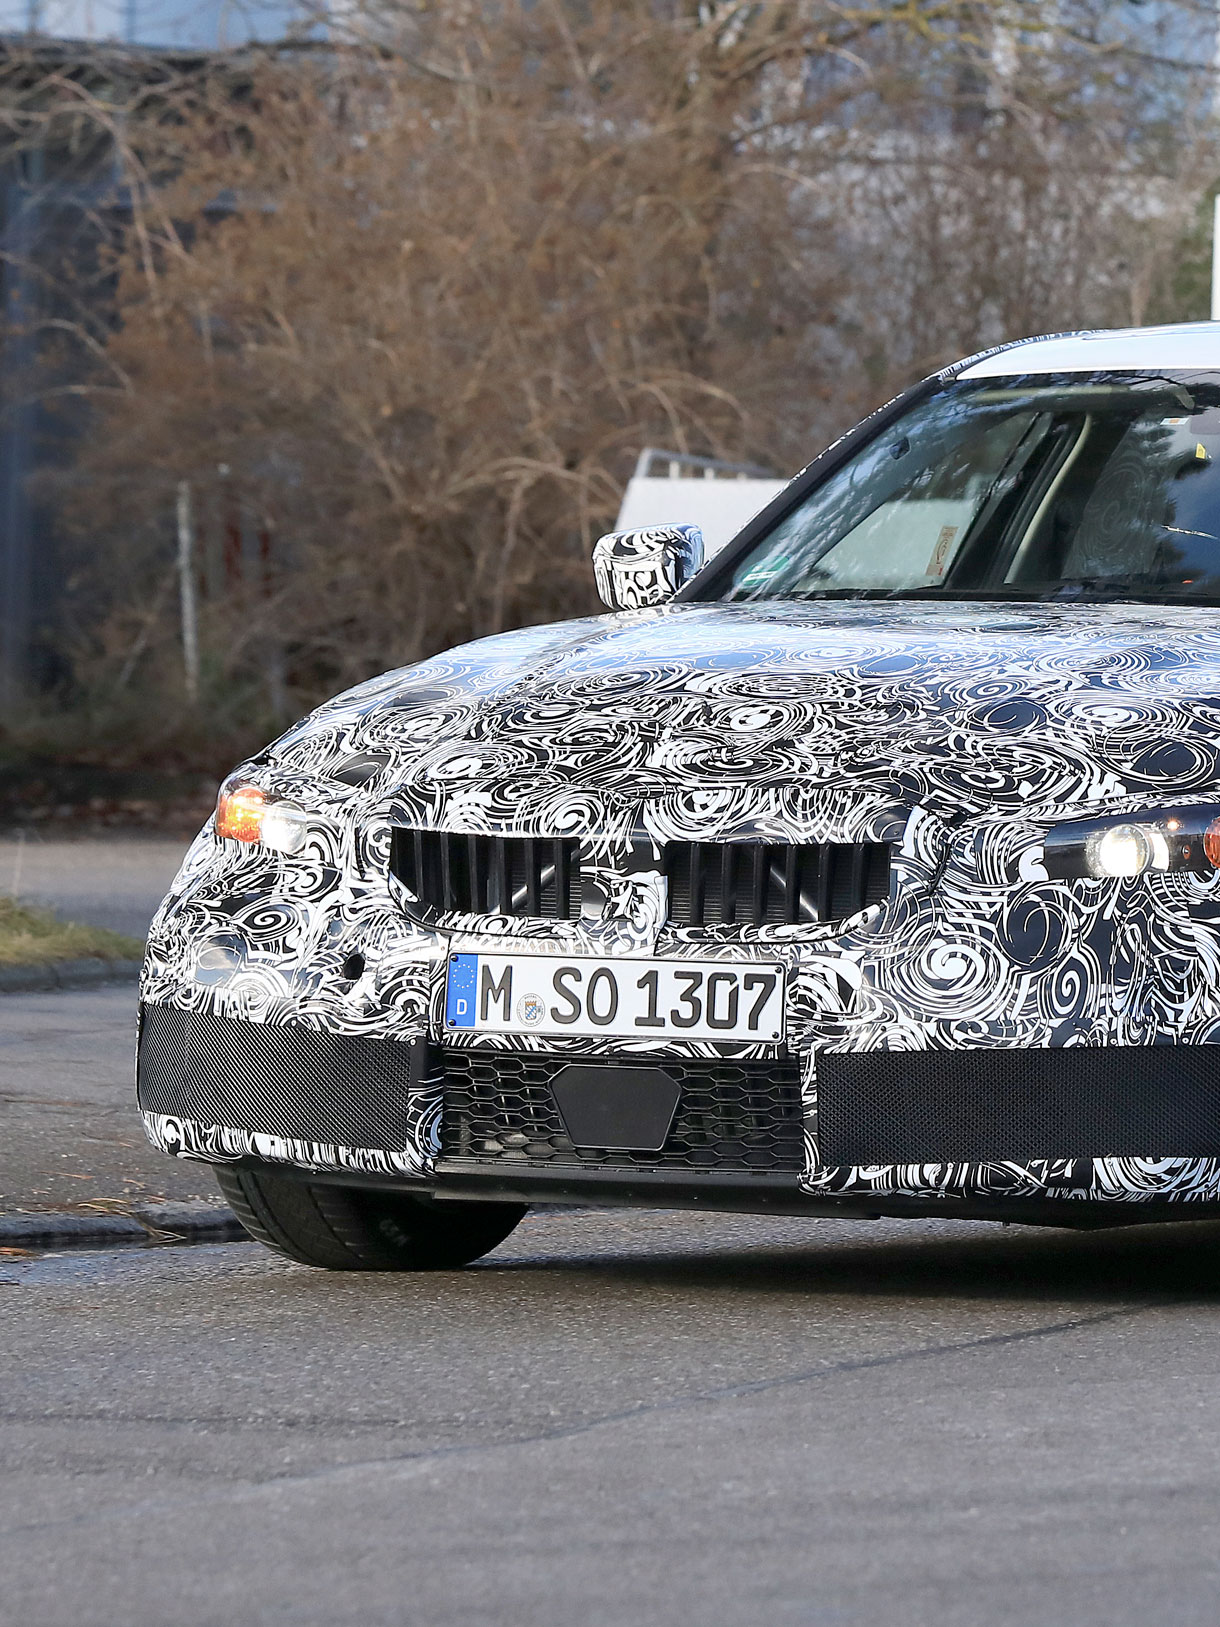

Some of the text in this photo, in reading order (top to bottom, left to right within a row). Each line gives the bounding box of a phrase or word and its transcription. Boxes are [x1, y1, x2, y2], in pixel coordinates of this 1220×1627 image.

[456, 998, 467, 1016] D
[480, 964, 513, 1021] M
[550, 966, 619, 1026] SO
[634, 969, 777, 1031] 1307
